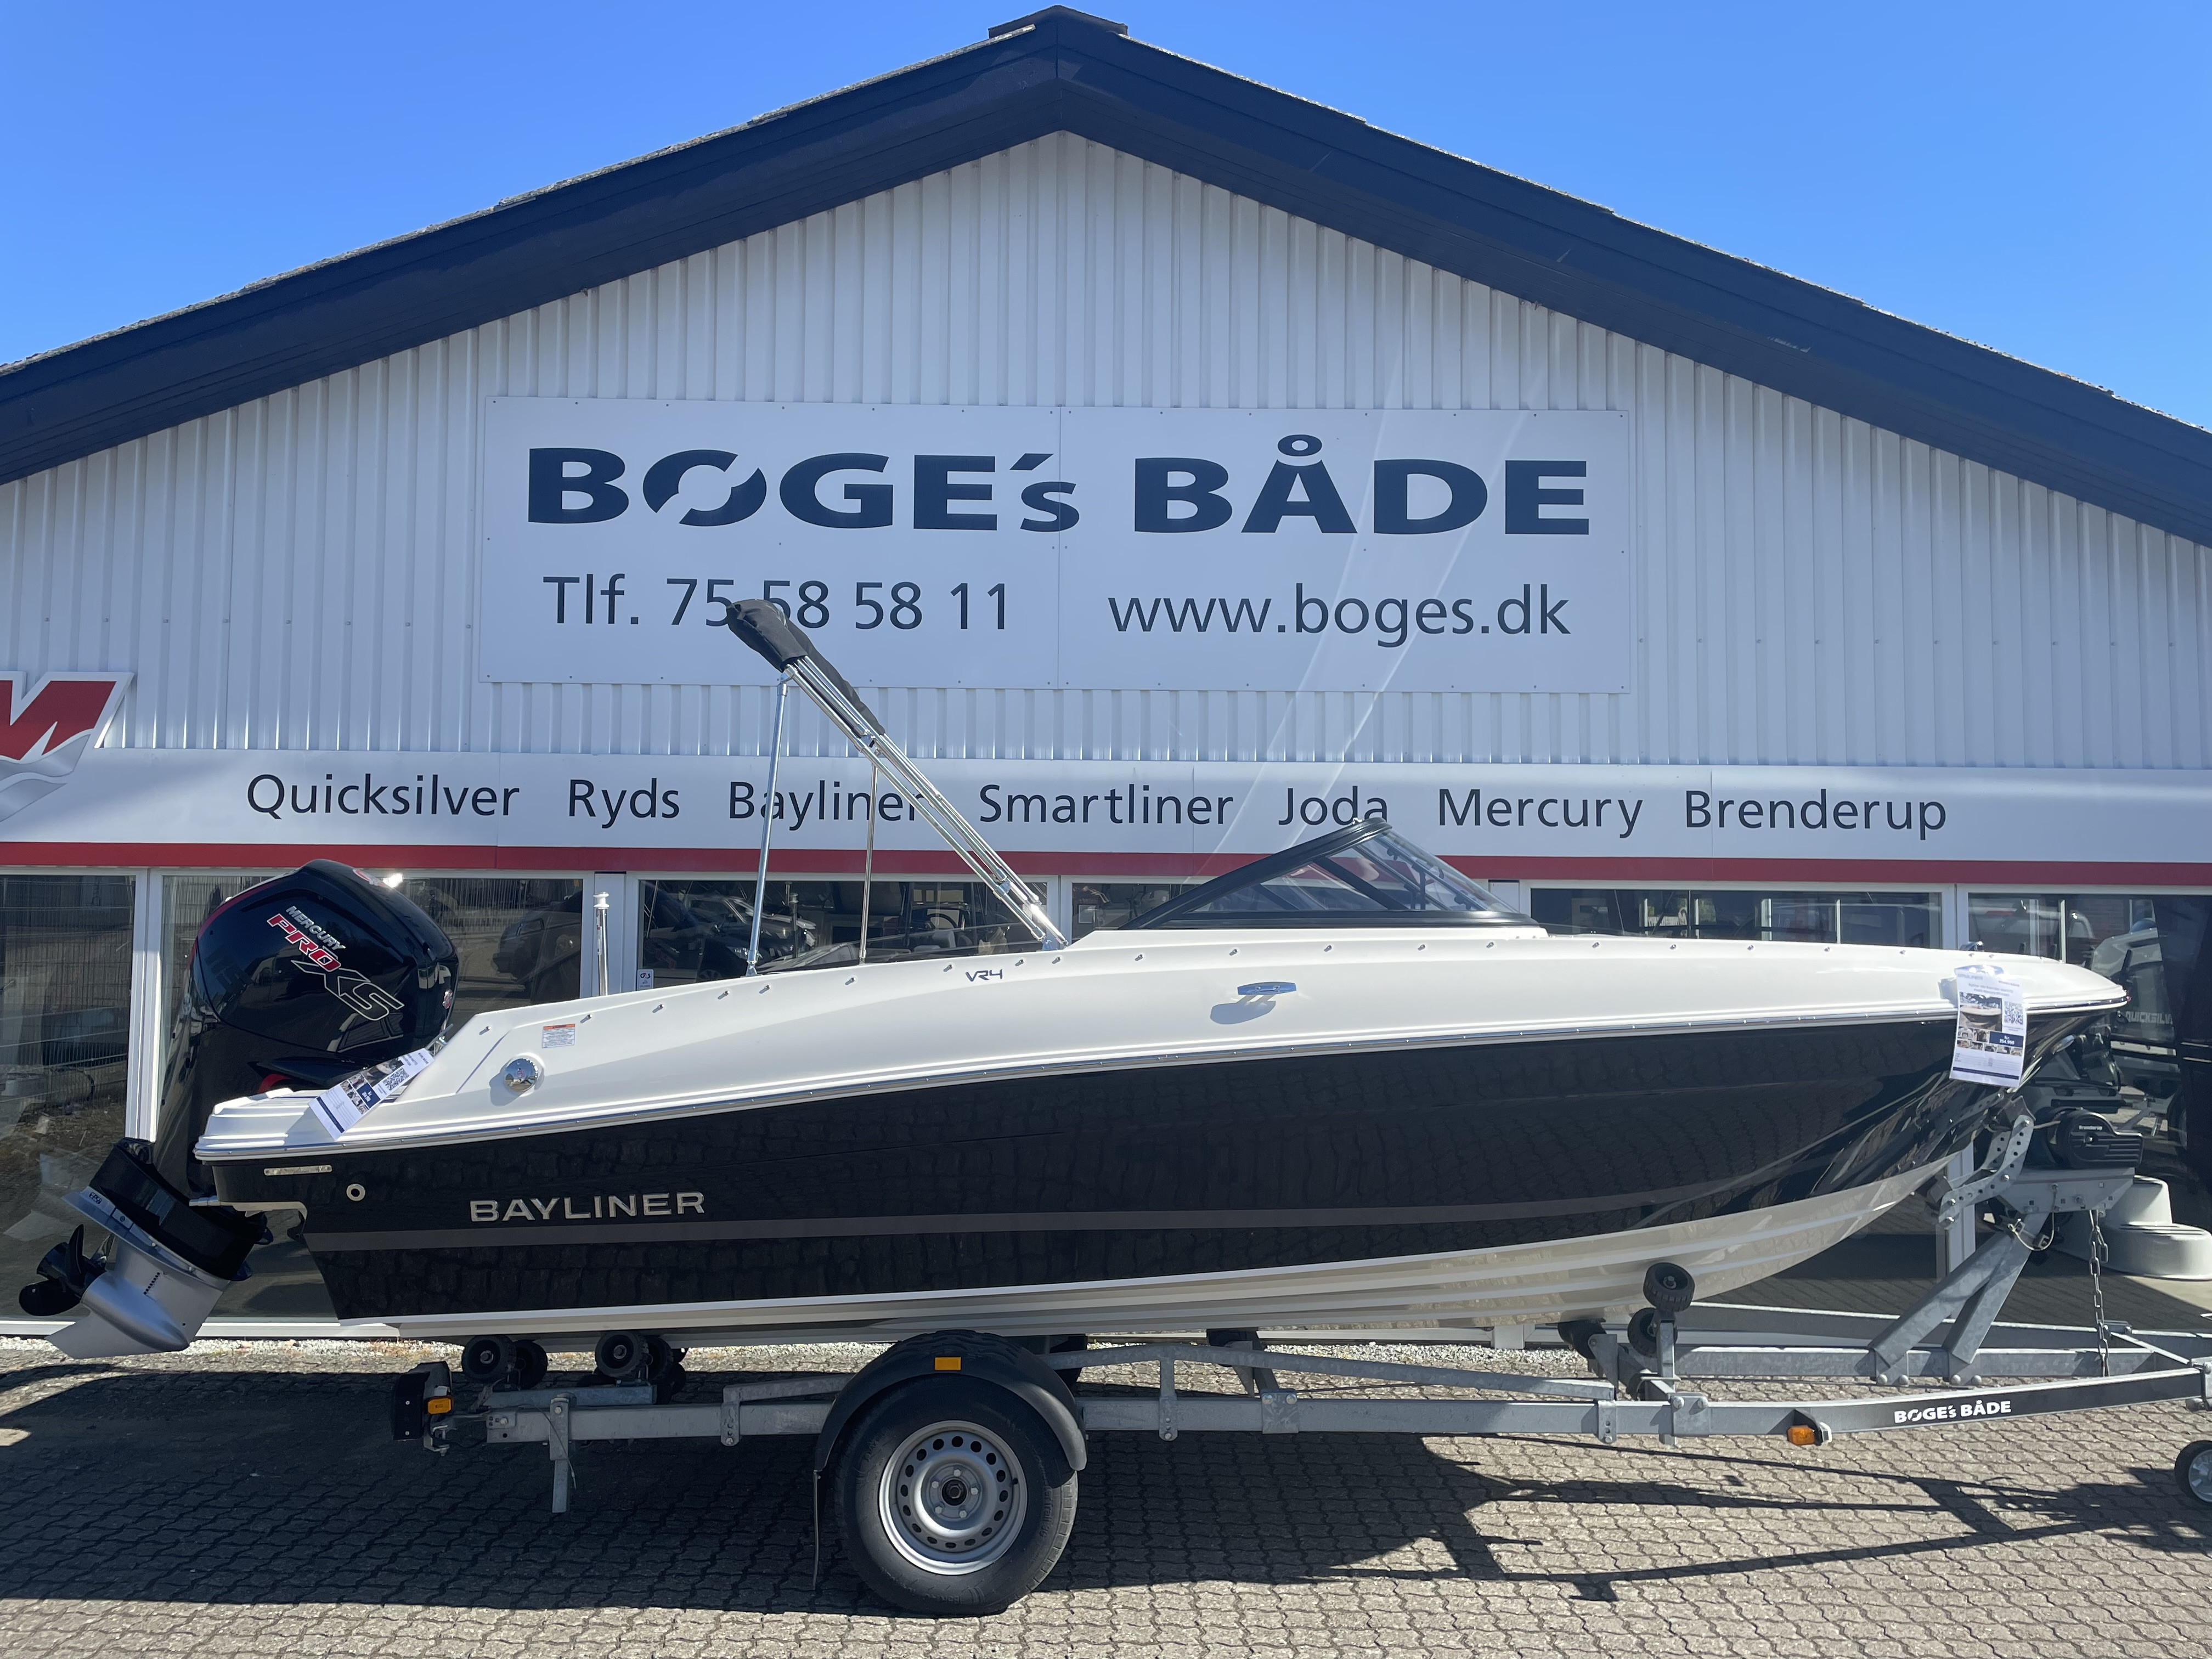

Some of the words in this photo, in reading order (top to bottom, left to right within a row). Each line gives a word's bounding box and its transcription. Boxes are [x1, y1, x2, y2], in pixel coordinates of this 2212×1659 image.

[1135, 434, 1589, 535] BÅDE
[543, 573, 639, 625] Tlf.
[667, 578, 733, 627] 75
[855, 582, 922, 630] 58
[951, 583, 1005, 630] 11
[1108, 583, 1571, 648] www.boges.dk
[247, 773, 520, 820] Quicksilver
[569, 777, 680, 829] Ryds
[980, 783, 1234, 825] Smartliner
[1278, 785, 1387, 826] Joda
[1439, 788, 1643, 839] Mercury
[1686, 788, 1946, 840] Brenderup
[267, 913, 342, 972] PRO
[286, 906, 346, 950] MERCURY
[291, 945, 405, 1021] XS
[965, 969, 1003, 982] VR4
[470, 1191, 705, 1222] BAYLINER
[1960, 1400, 2012, 1417] BÅDE
